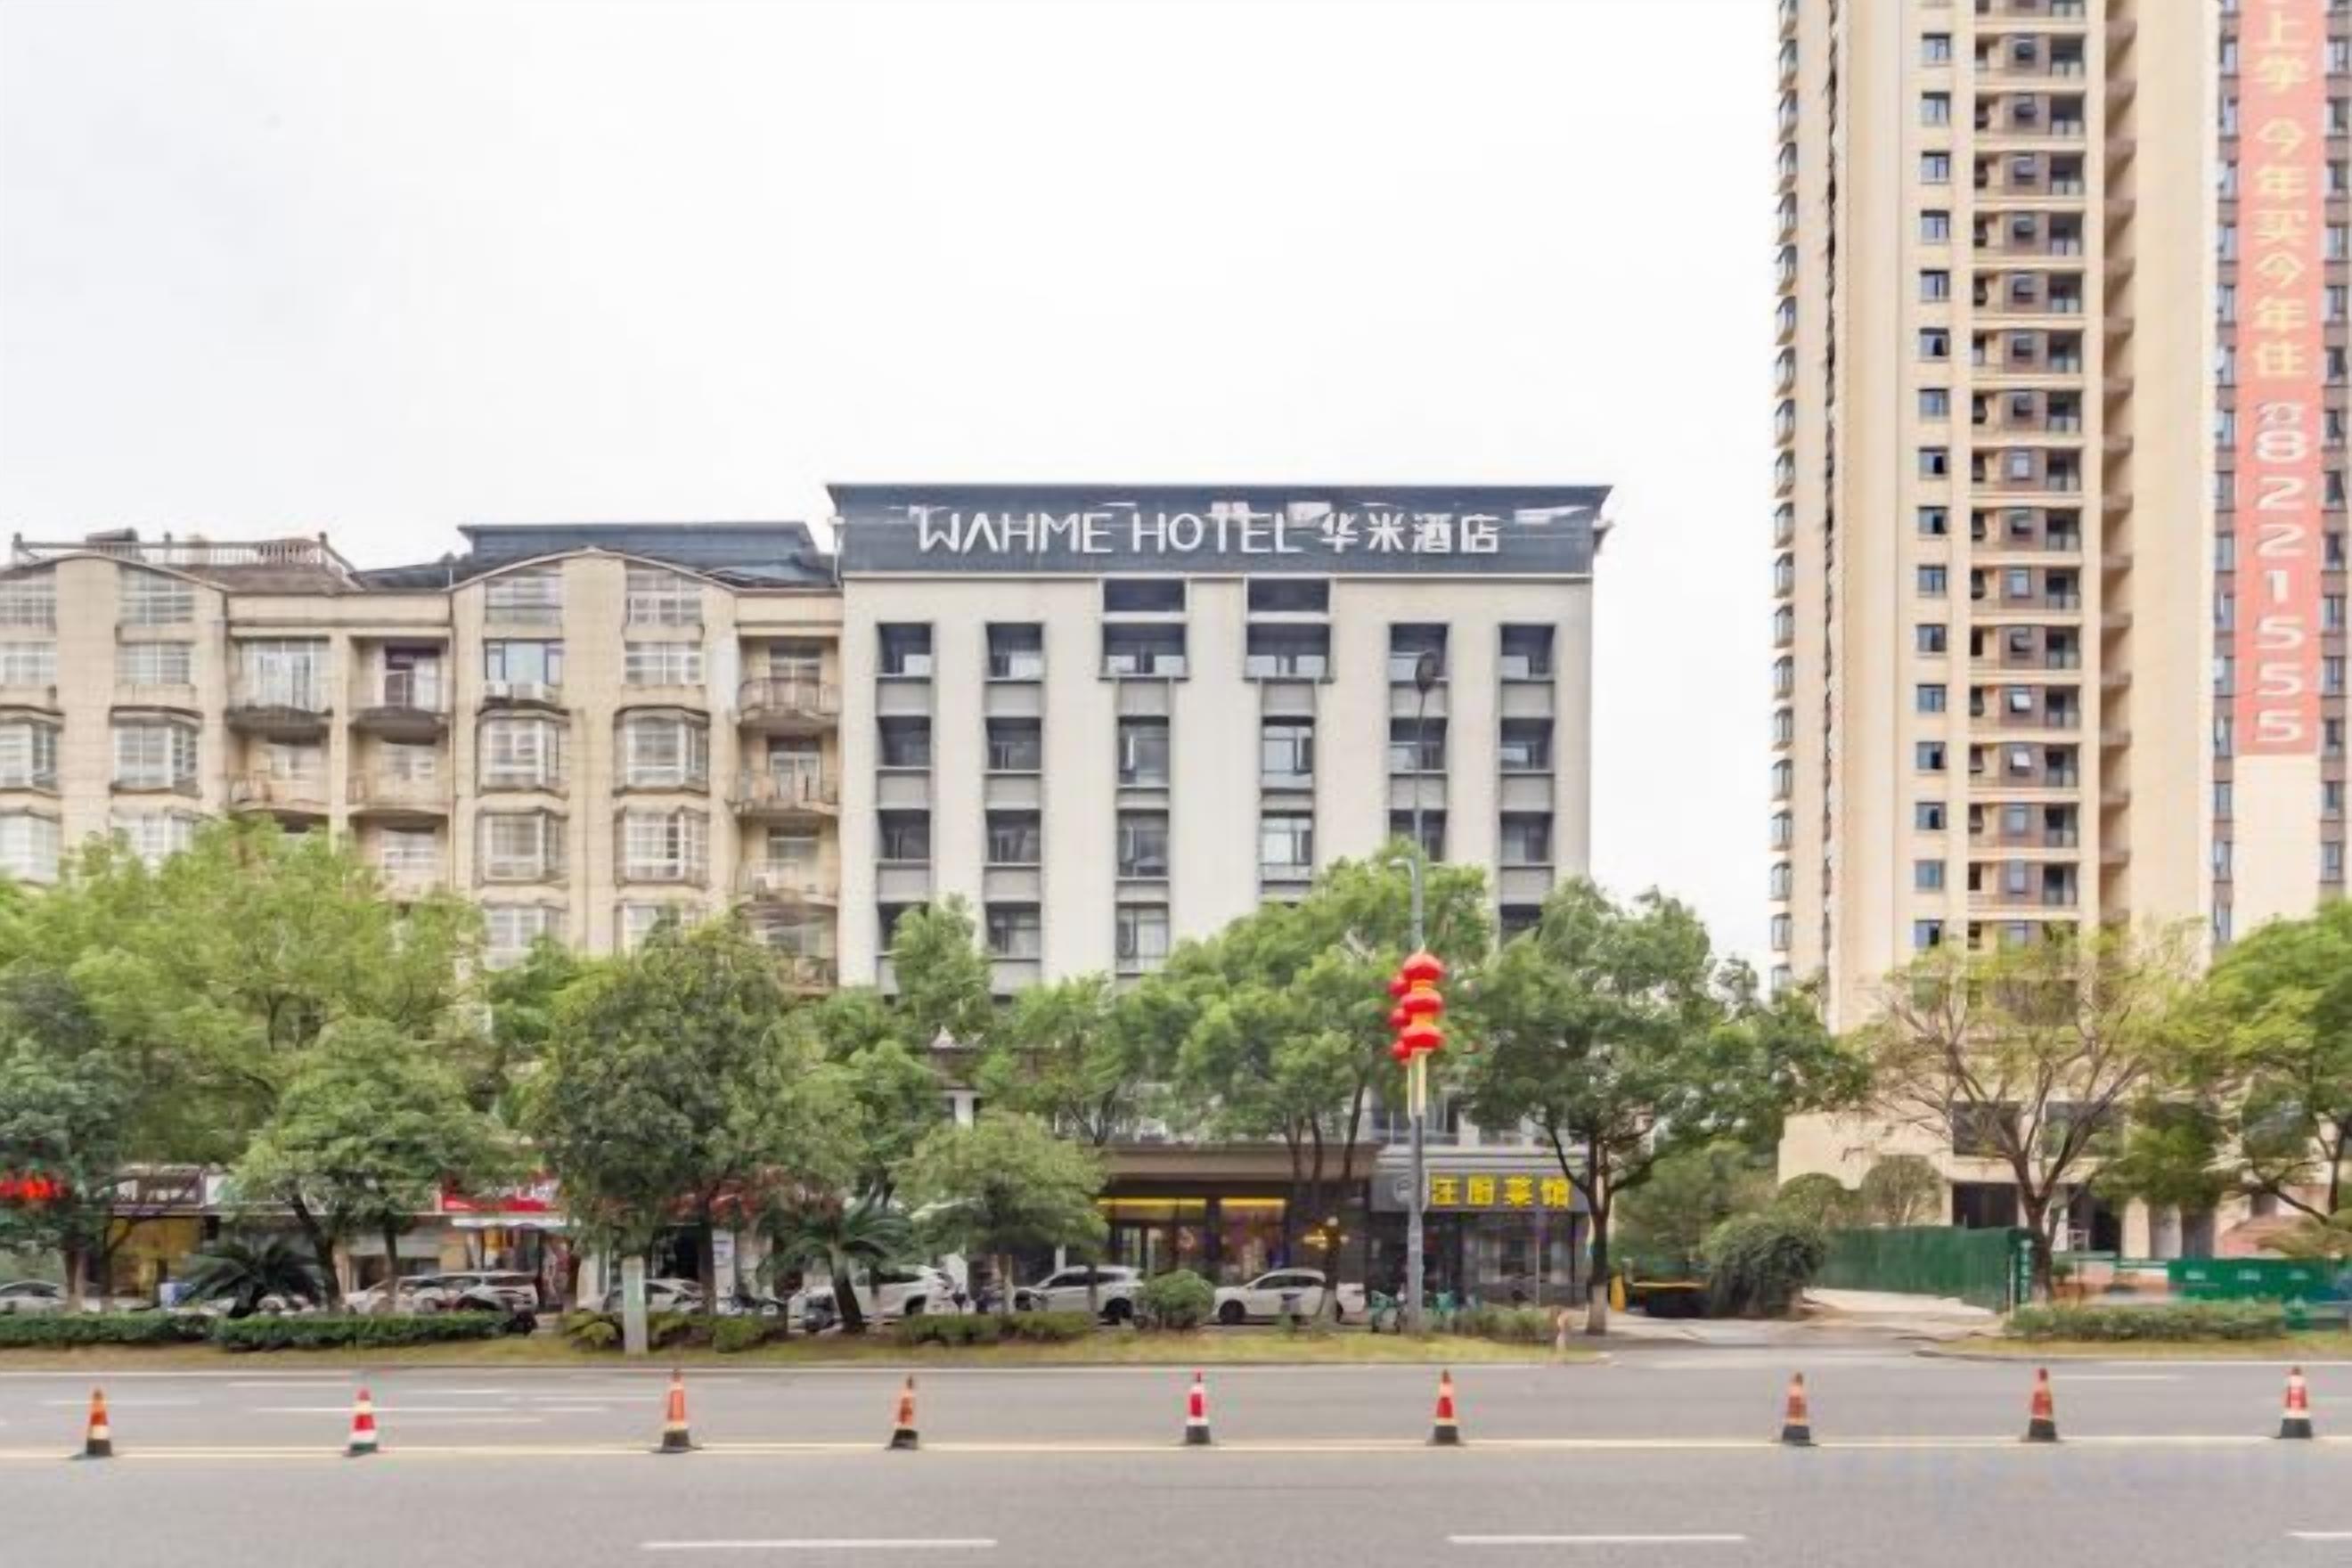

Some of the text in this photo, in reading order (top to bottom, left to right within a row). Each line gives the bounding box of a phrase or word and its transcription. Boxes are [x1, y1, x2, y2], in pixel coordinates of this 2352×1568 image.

[919, 512, 1500, 553] WAHME HOTEL 华米酒店
